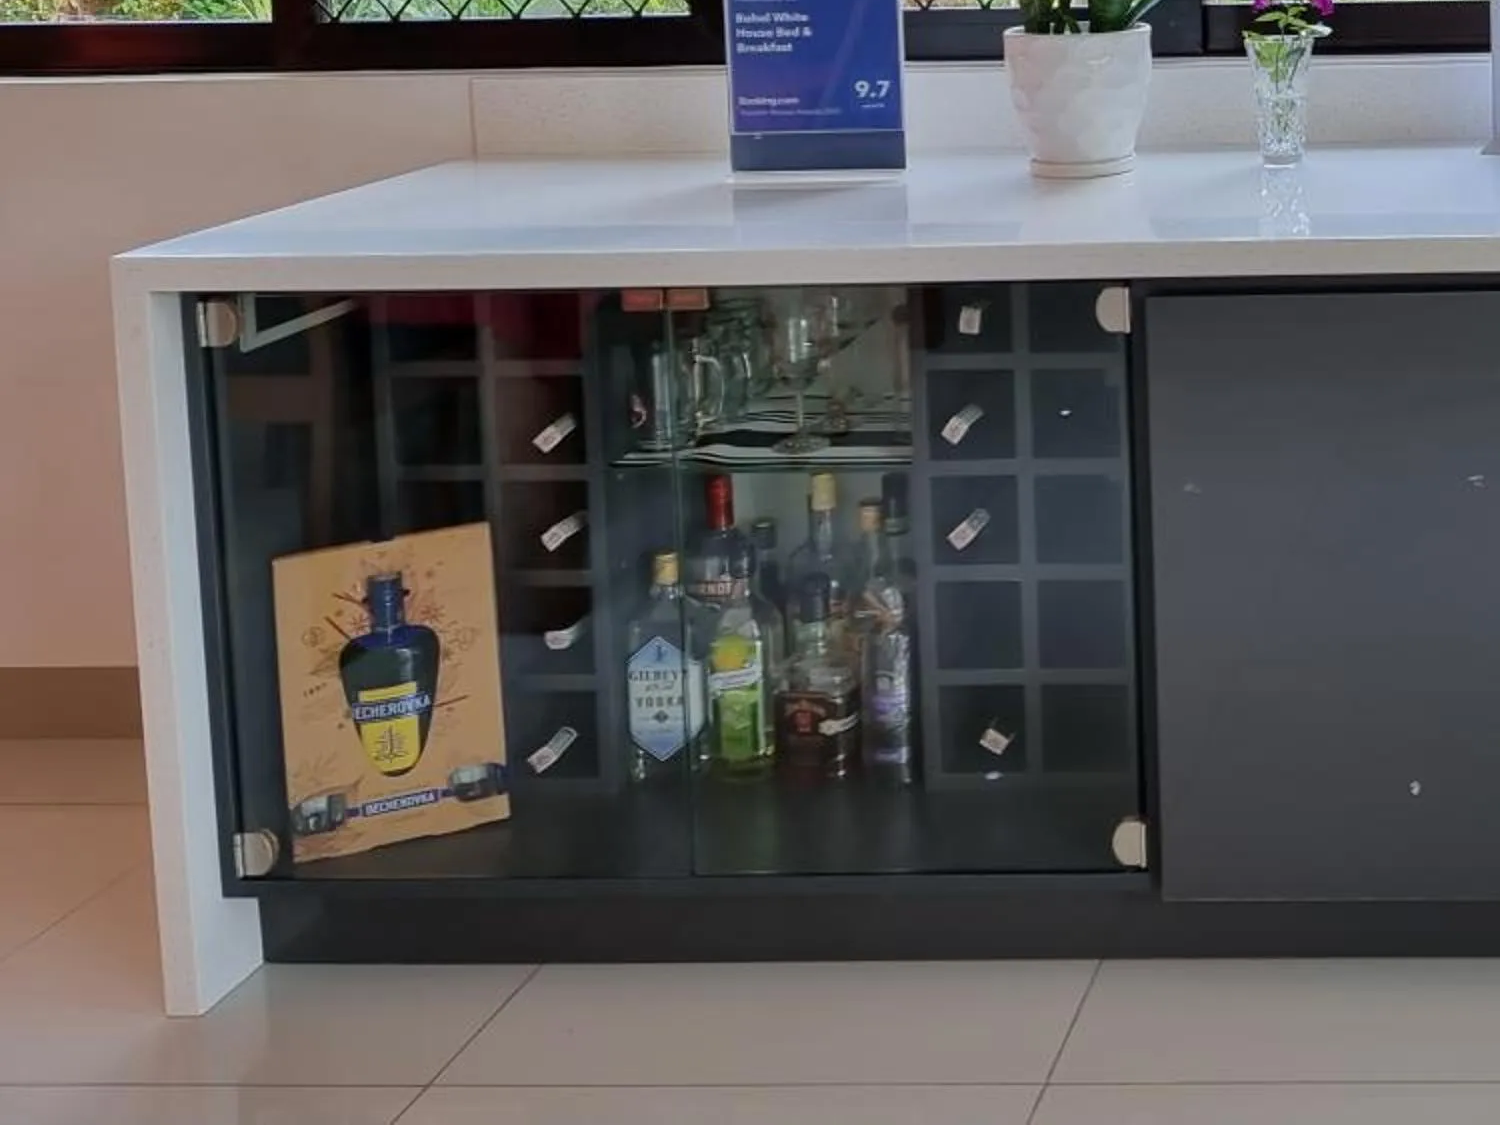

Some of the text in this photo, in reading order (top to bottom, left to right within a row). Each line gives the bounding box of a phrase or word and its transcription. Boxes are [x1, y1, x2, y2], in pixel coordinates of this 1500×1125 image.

[772, 11, 809, 23] White
[735, 26, 812, 38] House Bed &
[736, 42, 793, 52] Breakfast
[854, 79, 891, 99] 9.7
[628, 669, 687, 682] GILBEY
[354, 694, 431, 720] ECHEROVKA
